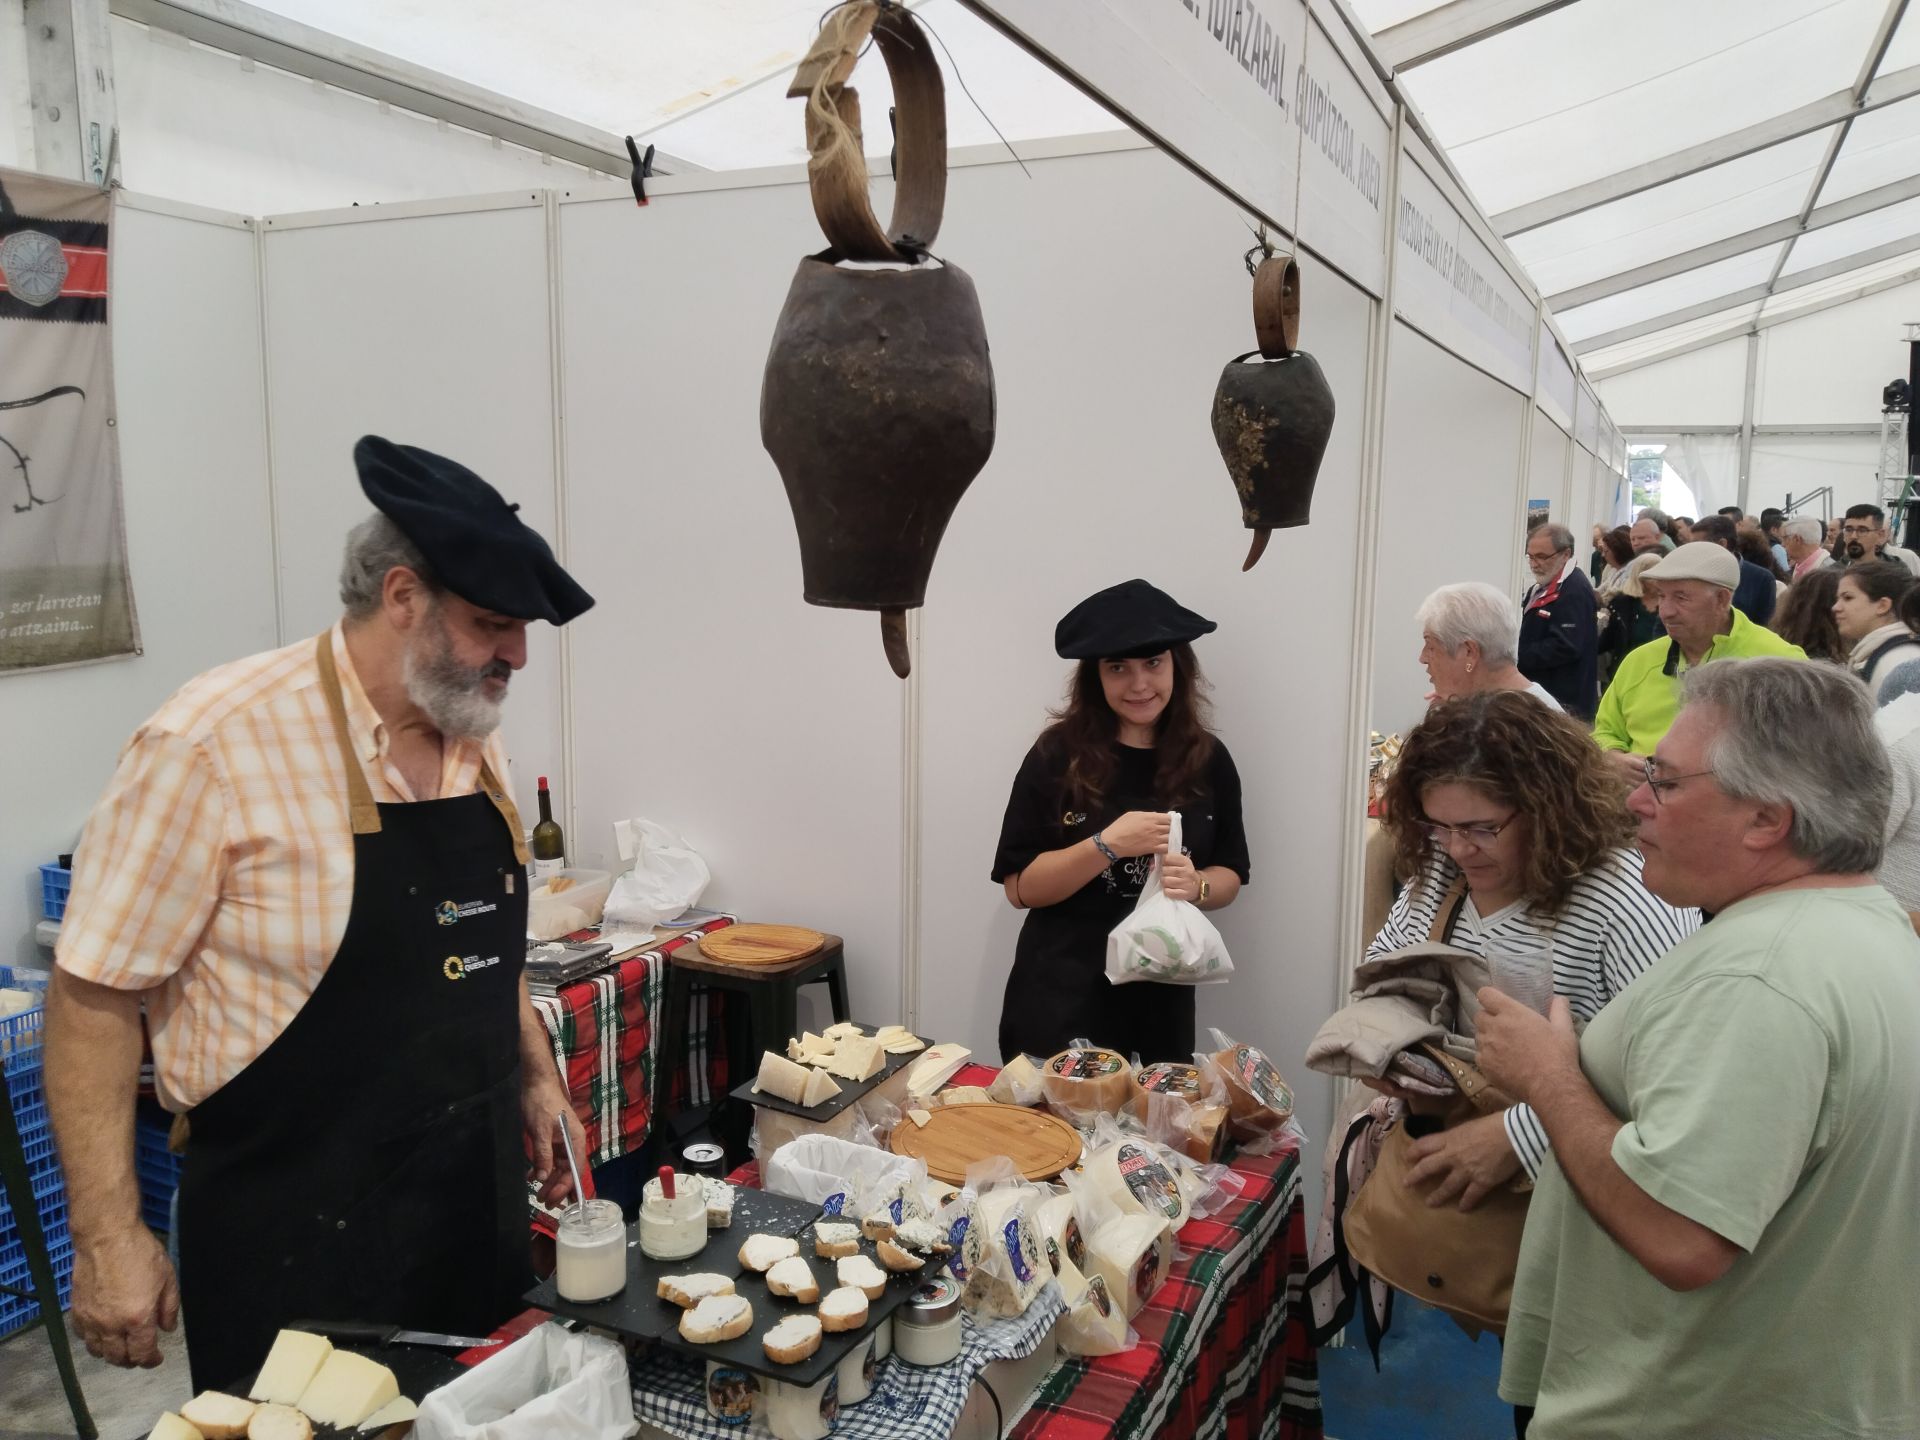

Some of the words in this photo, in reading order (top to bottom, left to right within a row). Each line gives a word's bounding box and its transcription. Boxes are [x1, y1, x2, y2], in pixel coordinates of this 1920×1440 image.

[1294, 64, 1356, 185] GUIPÚZCOA.
[1399, 196, 1424, 256] UESOS
[36, 594, 102, 612] larretan
